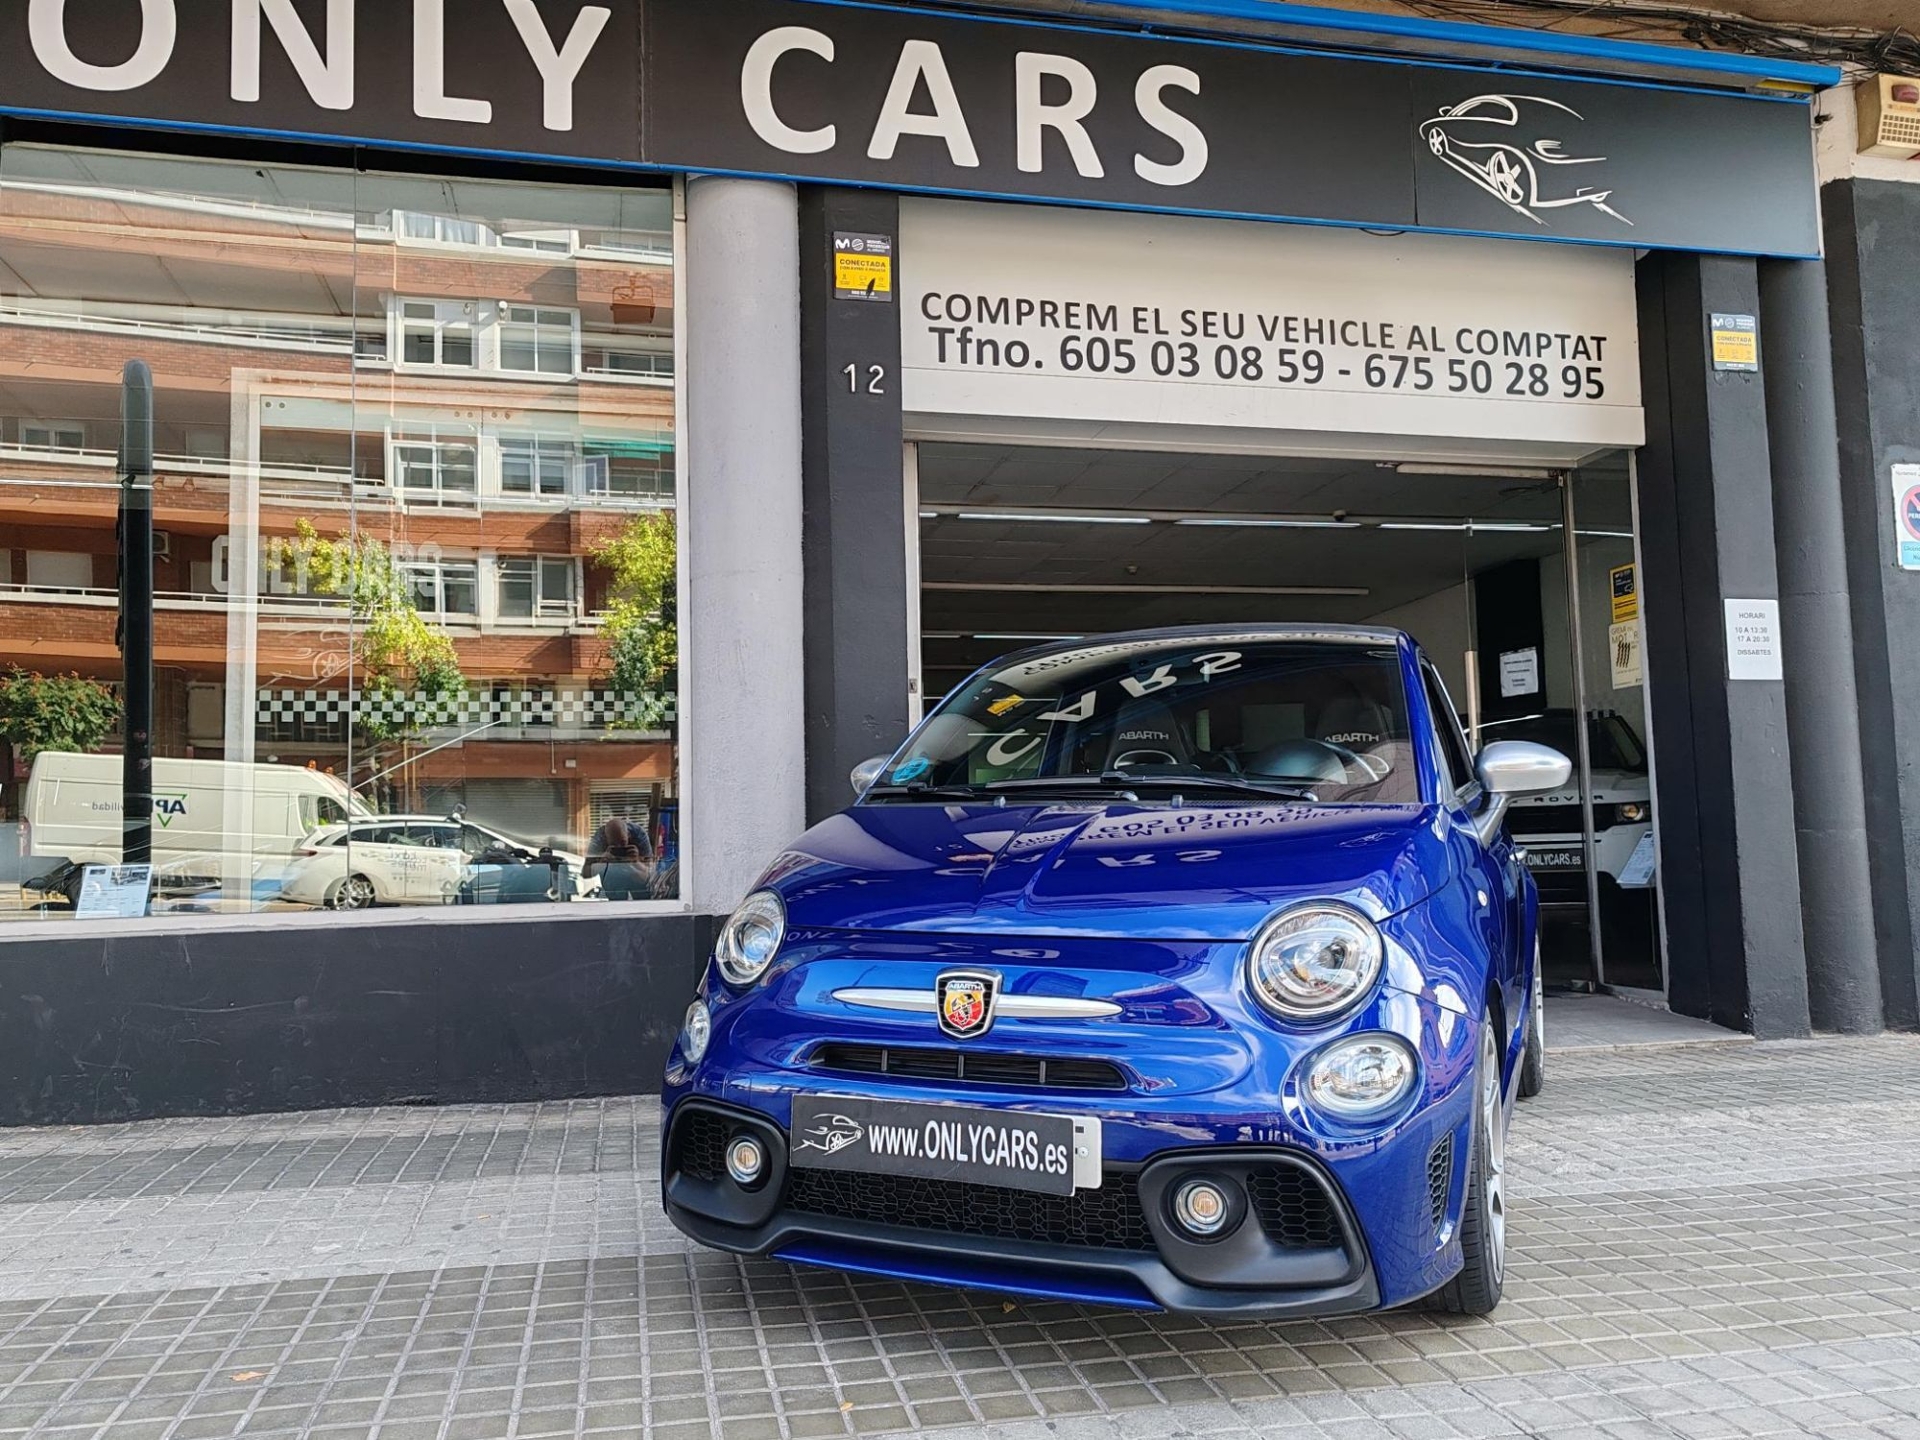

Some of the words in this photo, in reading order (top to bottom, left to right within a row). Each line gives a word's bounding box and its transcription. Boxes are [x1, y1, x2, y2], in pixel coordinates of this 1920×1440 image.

[28, 0, 611, 131] ONLY
[741, 26, 1209, 186] CARS
[840, 259, 886, 268] CONECTADA
[921, 292, 1118, 332] COMPREM
[1133, 306, 1169, 335] EL
[1180, 309, 1245, 340] SEU
[1257, 314, 1395, 349] VEHICLE
[1406, 325, 1446, 352] AL
[1455, 328, 1607, 362] COMPTAT
[928, 326, 1044, 369] Tfno.
[1060, 335, 1136, 373] 605
[1151, 341, 1200, 377] 03
[1214, 344, 1263, 381] 08
[1278, 348, 1324, 384] 59
[1364, 353, 1434, 390] 675
[1448, 359, 1492, 393] 50
[1505, 362, 1549, 396] 28
[1561, 365, 1605, 399] 95
[842, 363, 884, 394] 12
[1118, 731, 1169, 741] ABARTH
[1534, 794, 1604, 803] ROVR
[1522, 853, 1581, 866] .ONLYCARS.es
[948, 982, 983, 991] ABARTH
[868, 1119, 1068, 1175] www.ONLYCARS.es
